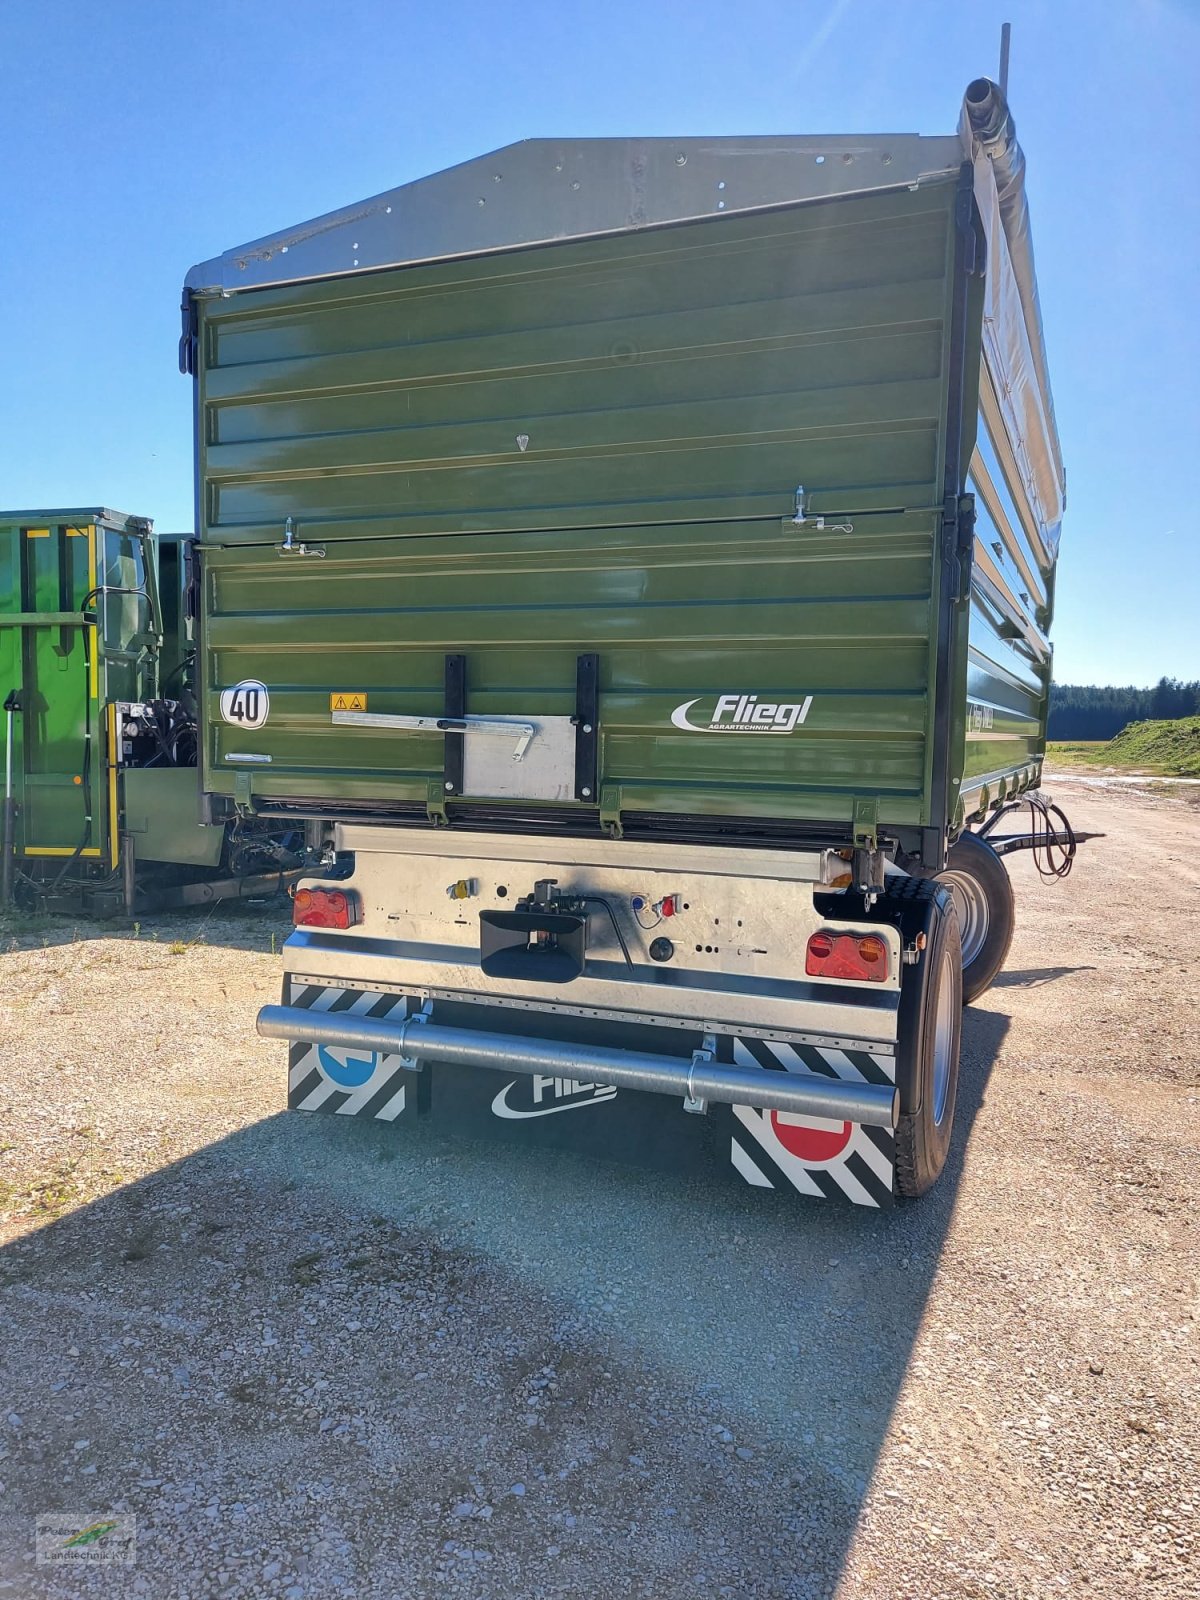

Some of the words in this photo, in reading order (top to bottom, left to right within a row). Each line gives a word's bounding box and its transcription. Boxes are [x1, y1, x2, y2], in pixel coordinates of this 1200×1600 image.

[229, 688, 259, 723] 40
[711, 694, 814, 731] Fliegl
[708, 723, 771, 731] AGRARTECHNIK
